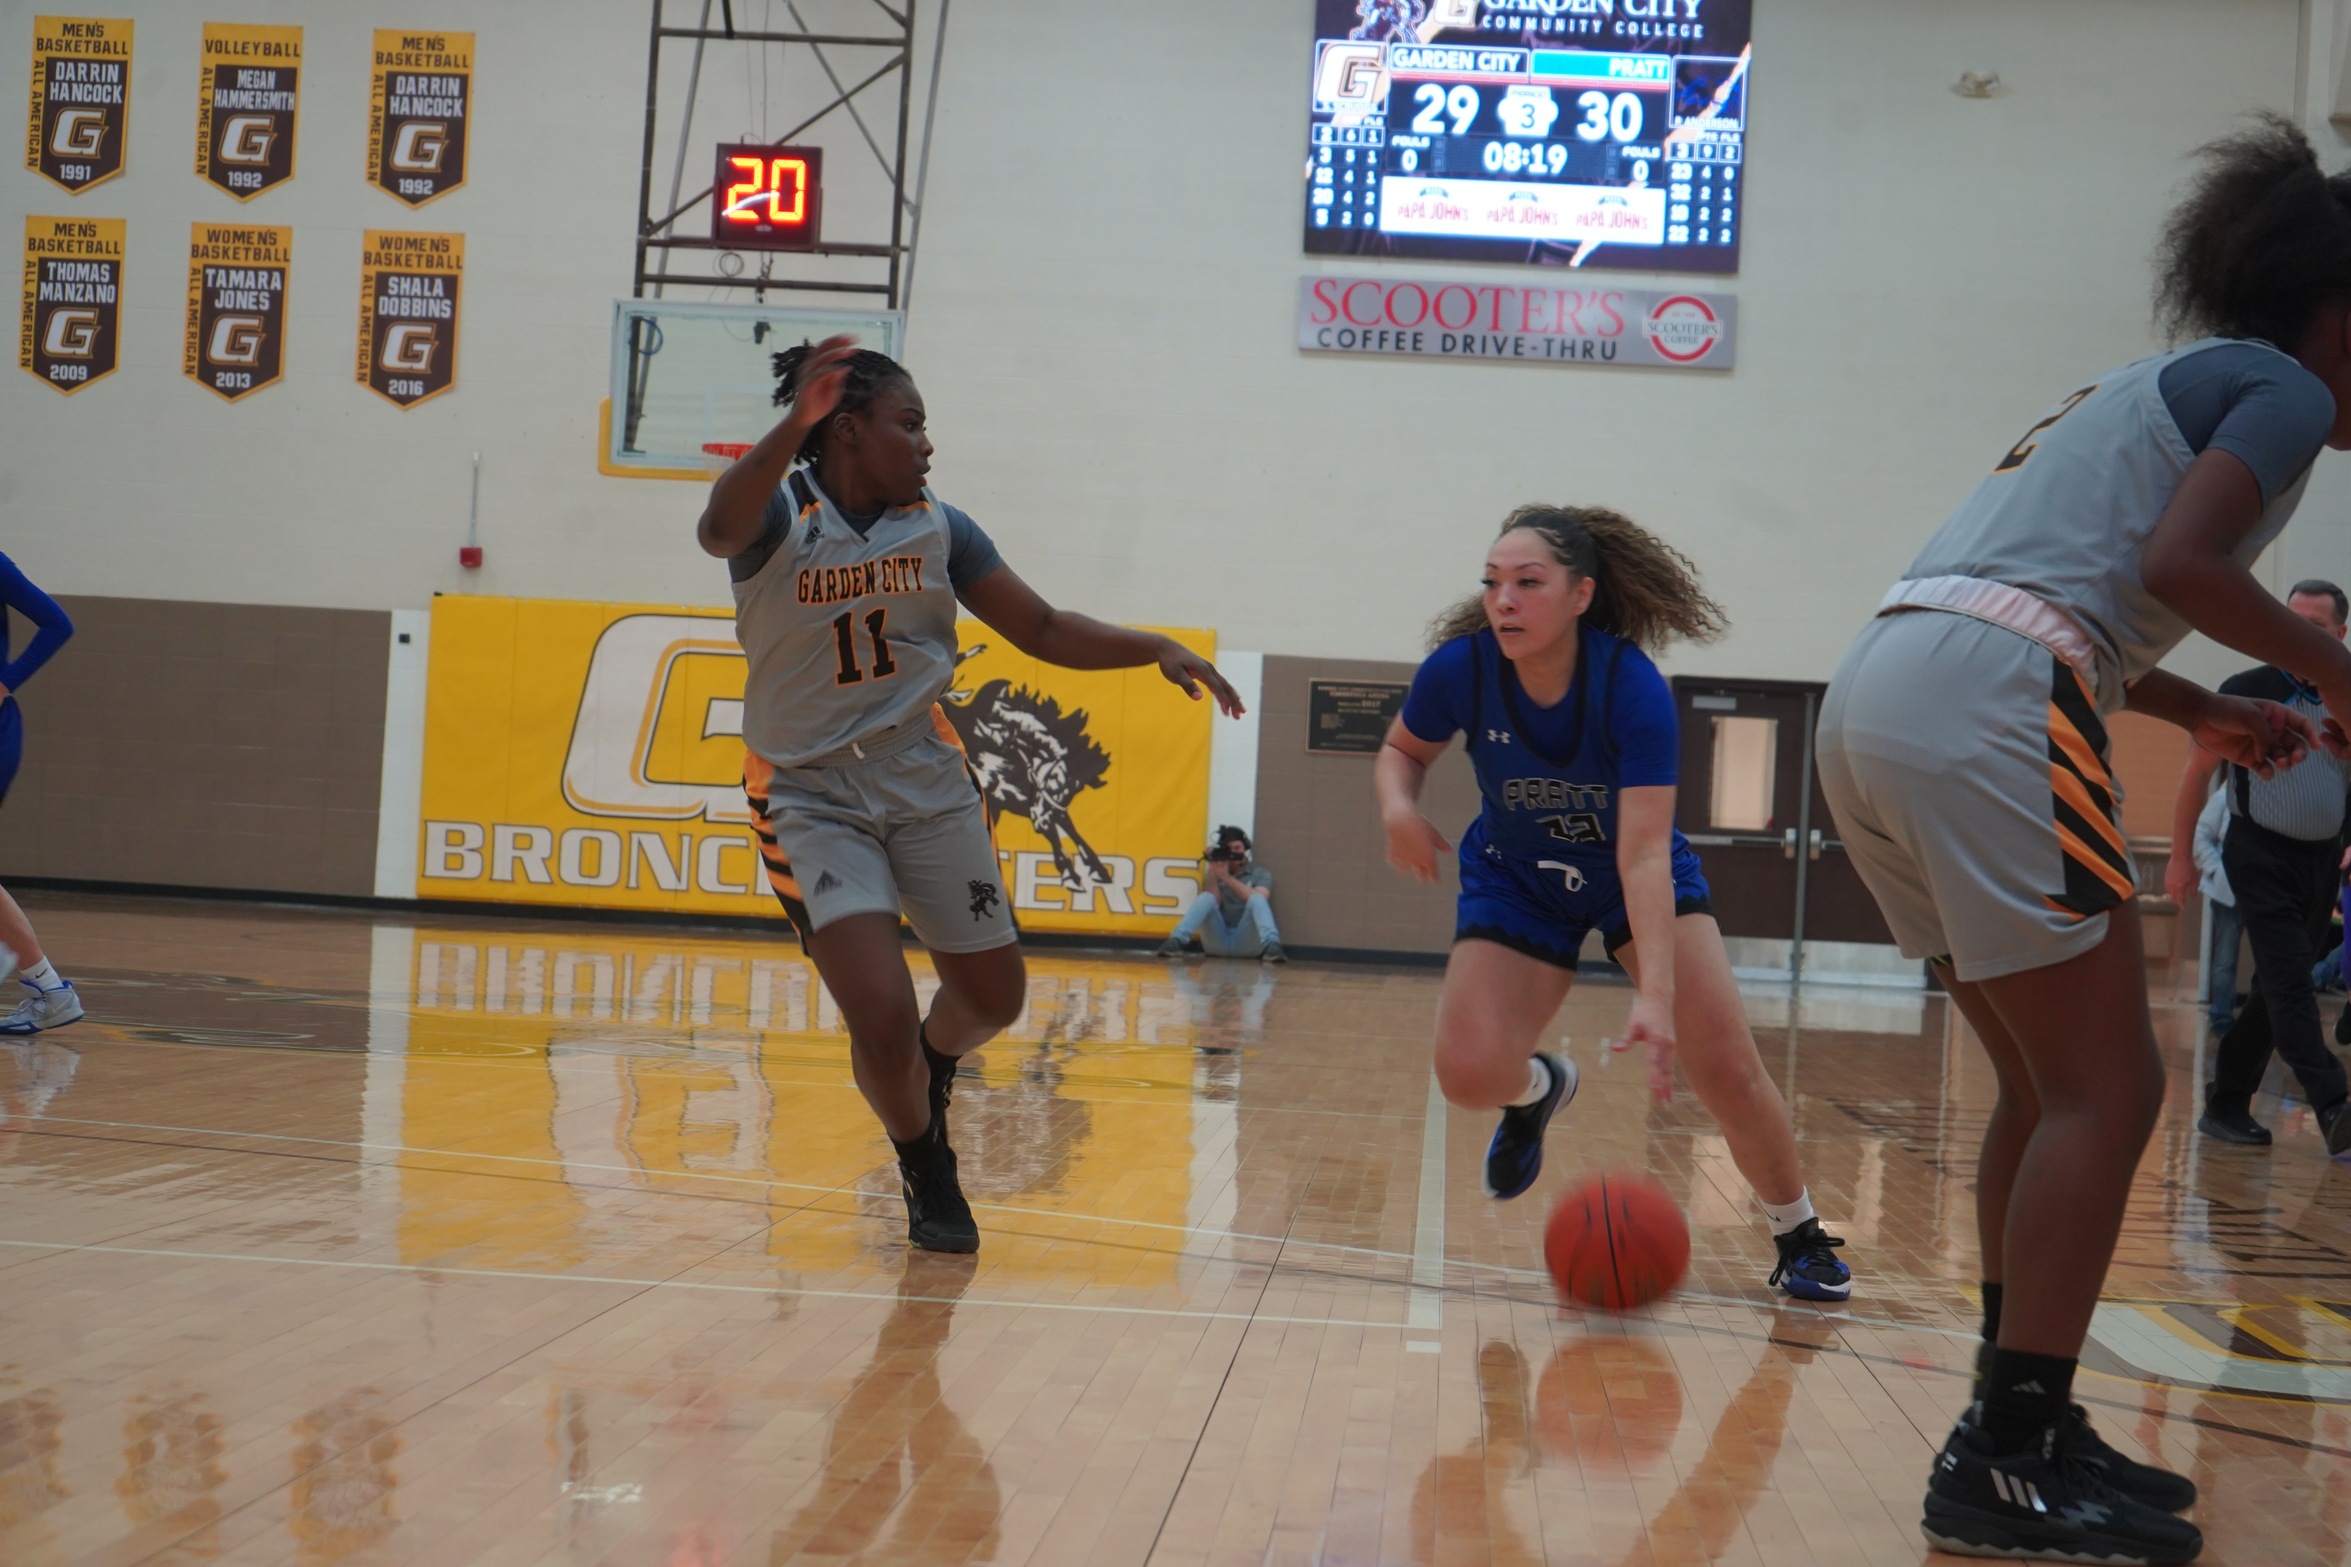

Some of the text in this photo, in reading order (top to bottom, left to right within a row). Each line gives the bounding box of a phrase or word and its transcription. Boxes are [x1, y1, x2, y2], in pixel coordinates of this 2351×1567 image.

[1624, 0, 1700, 18] CITY
[63, 22, 104, 37] MEN'S
[1482, 14, 1704, 38] COMMUNITY COLLEGE
[37, 38, 128, 55] BASKETBALL
[205, 40, 300, 57] VOLLEYBALL
[402, 35, 445, 51] MEN'S
[376, 52, 469, 68] BASKETBALL
[1393, 48, 1521, 72] GARDEN CITY
[1608, 58, 1668, 78] PRATT
[55, 61, 119, 83] DARRIN
[237, 69, 276, 89] MEGAN
[50, 82, 122, 103] HANCOCK
[395, 76, 460, 97] DARRIN
[214, 88, 295, 111] HAMMERSMITH
[390, 96, 463, 118] HANCOCK
[1411, 83, 1480, 135] 29
[28, 60, 44, 167] ALL AMERICAN
[196, 67, 213, 174] ALL AMERICAN
[1521, 103, 1535, 129] 3
[1576, 90, 1643, 142] 30
[367, 74, 384, 181] ALL AMERICAN
[1391, 135, 1430, 147] FOULS
[1402, 148, 1418, 171] 0
[1483, 141, 1568, 176] 08:19
[1622, 146, 1661, 158] FOULS
[60, 164, 91, 180] 1991
[228, 171, 262, 187] 1992
[1343, 169, 1354, 183] 4
[1632, 159, 1649, 181] 0
[1701, 165, 1711, 179] 4
[1724, 166, 1734, 180] 0
[399, 178, 433, 195] 1992
[727, 157, 806, 222] 20
[1701, 186, 1711, 200] 2
[1723, 187, 1732, 201] 1
[1343, 190, 1353, 204] 4
[1365, 191, 1375, 205] 2
[1342, 211, 1352, 225] 2
[1364, 211, 1374, 225] 0
[1700, 207, 1710, 221] 2
[1722, 208, 1732, 222] 2
[54, 221, 96, 237] MEN'S
[207, 229, 277, 246] WOMEN'S
[1699, 228, 1709, 242] 2
[1721, 229, 1731, 243] 2
[28, 237, 120, 255] BASKETBALL
[191, 244, 290, 262] BASKETBALL
[379, 235, 450, 252] WOMEN'S
[363, 251, 463, 269] BASKETBALL
[47, 261, 110, 283] THOMAS
[205, 268, 282, 290] TAMARA
[39, 282, 116, 304] MANZANO
[388, 276, 444, 297] SHALA
[215, 289, 270, 311] JONES
[378, 296, 452, 319] DOBBINS
[1311, 278, 1624, 338] SCOOTER'S
[20, 260, 36, 367] ALL AMERICAN
[185, 268, 200, 375] ALL AMERICAN
[357, 274, 373, 382] ALL AMERICAN
[1648, 320, 1719, 336] SCOOTER'S
[1317, 327, 1617, 361] COFFEE DRIVE-THRU
[1664, 334, 1699, 345] COFFEE
[50, 364, 88, 380] 2009
[216, 371, 251, 388] 2013
[388, 379, 424, 396] 2016
[797, 556, 924, 604] GARDEN CITY
[833, 607, 896, 688] 11
[1502, 777, 1610, 811] PRATT
